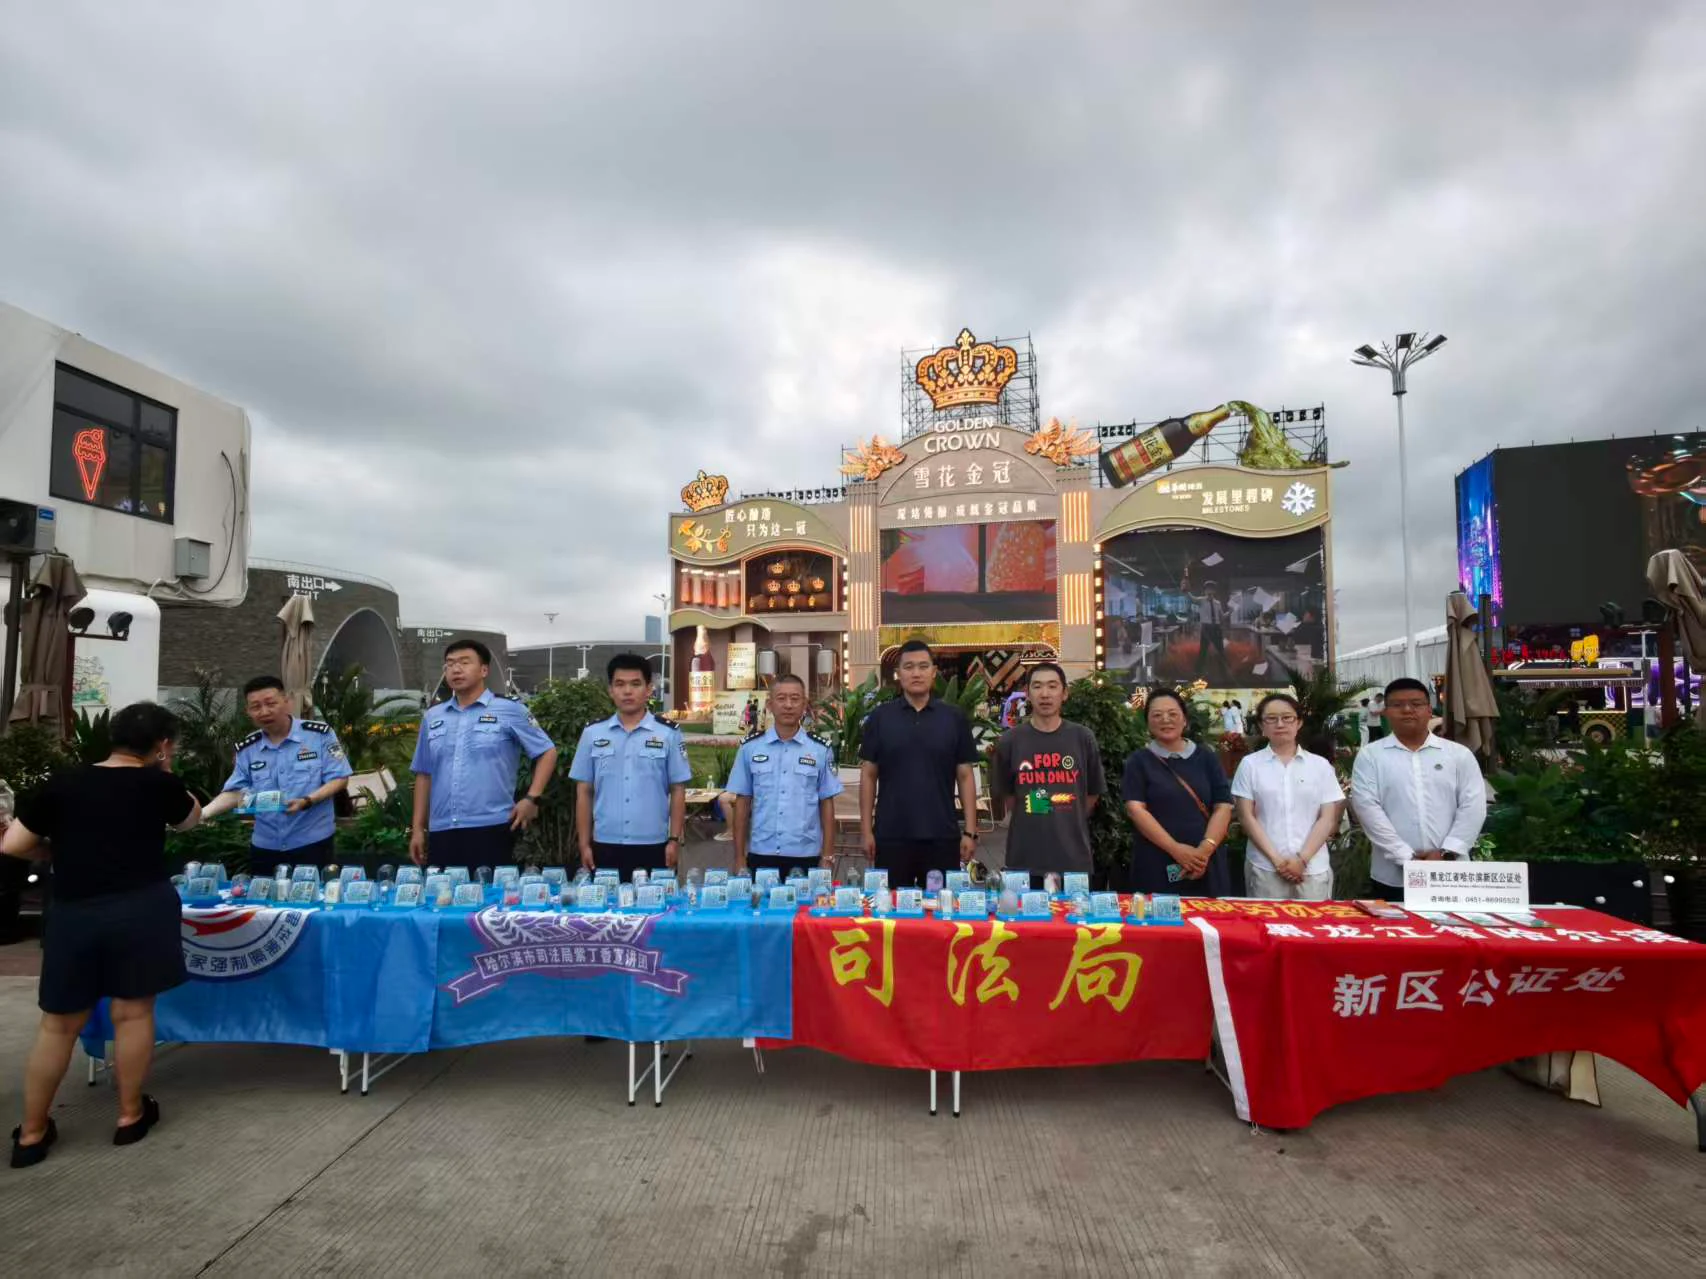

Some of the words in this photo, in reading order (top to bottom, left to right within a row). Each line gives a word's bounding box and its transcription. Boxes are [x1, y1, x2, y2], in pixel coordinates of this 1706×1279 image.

[934, 417, 993, 433] GOLDEN
[924, 432, 1000, 453] CROWN
[913, 460, 1010, 489] 雪花金冠
[1202, 487, 1273, 506] 发展里程碑
[1202, 505, 1249, 514] MILESTONES
[746, 520, 807, 537] 只为这一冠
[287, 574, 325, 590] 南出口
[417, 628, 444, 638] 南出口
[1034, 752, 1061, 769] FOR
[1019, 771, 1045, 785] FUN
[1047, 769, 1080, 784] ONLY
[1430, 871, 1522, 884] 黑龙江省哈尔滨新区公证处
[183, 911, 302, 974] 家强制隔离戒毒
[484, 946, 649, 972] 哈尔滨市司法局紫丁香宣讲团
[830, 917, 1143, 1012] 司法局
[1332, 965, 1626, 1018] 新区公证处
